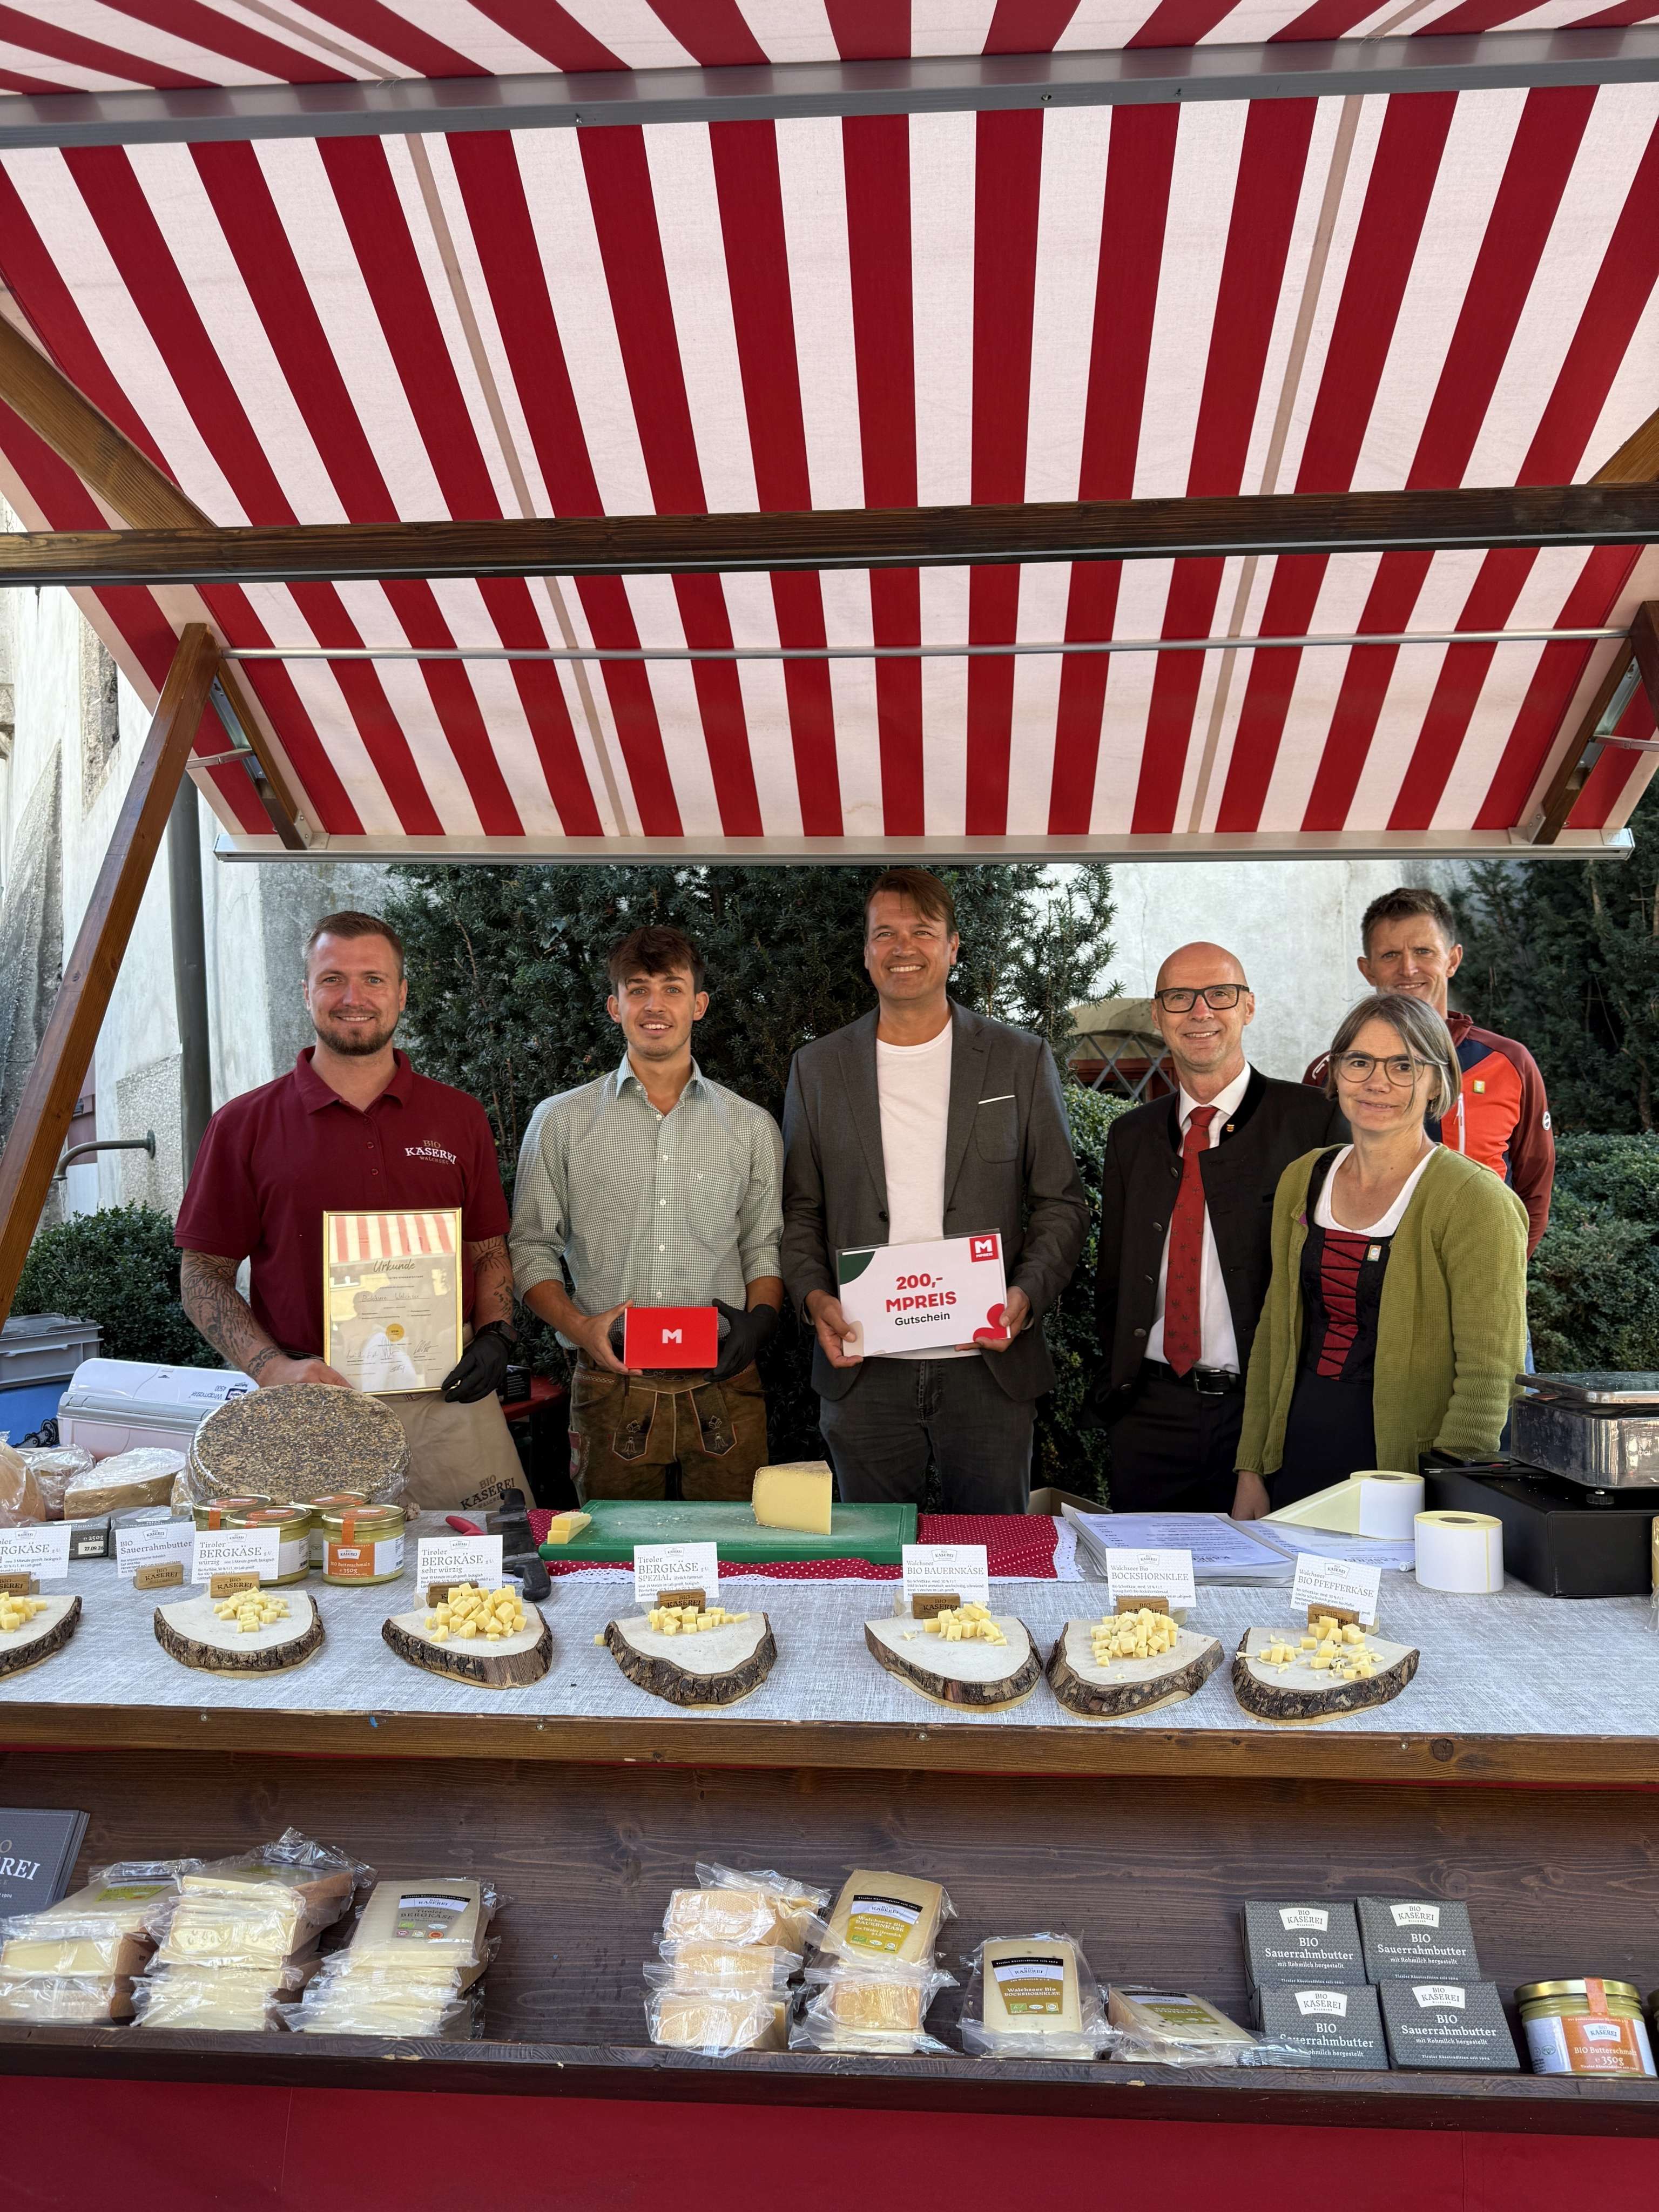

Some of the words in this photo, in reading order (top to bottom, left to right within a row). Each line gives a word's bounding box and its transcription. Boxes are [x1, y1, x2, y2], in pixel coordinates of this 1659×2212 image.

[423, 1140, 441, 1149] BIO
[974, 1239, 993, 1253] M
[373, 1259, 416, 1272] Urkunde
[895, 1273, 943, 1290] 200,-
[886, 1291, 957, 1312] MPREIS
[895, 1312, 950, 1326] Gutschein
[662, 1329, 682, 1344] M
[480, 1475, 496, 1489] BIO
[0, 1542, 49, 1554] RGKÄSE
[120, 1541, 192, 1554] Sauerrahmbutter
[199, 1545, 261, 1558] BERGKÄSE
[422, 1553, 483, 1566] BERGKÄSE
[639, 1560, 698, 1574] BERGKÄSE
[925, 1565, 984, 1575] BAUERNKÄSE
[638, 1574, 671, 1582] SPEZIAL
[1112, 1573, 1189, 1581] BOCKSHORNKLEE
[1299, 1569, 1325, 1579] Walchseer
[1298, 1576, 1312, 1584] BIO
[1314, 1579, 1374, 1597] PFEFFERKÄSE
[858, 1916, 892, 1925] Walchseer
[1299, 1937, 1319, 1947] BIO
[1411, 1933, 1431, 1943] BIO
[1265, 1948, 1353, 1960] Sauerrahmbutter
[1378, 1944, 1467, 1956] Sauerrahmbutter
[1436, 2014, 1458, 2024] BIO
[1315, 2022, 1337, 2033] BIO
[1401, 2025, 1496, 2036] Sauerrahmbutter
[1280, 2034, 1374, 2047] Serrahmbutter
[1332, 2049, 1364, 2058] hergestellt
[1590, 2047, 1637, 2056] Butterschmalz
[1602, 2056, 1624, 2066] 350g
